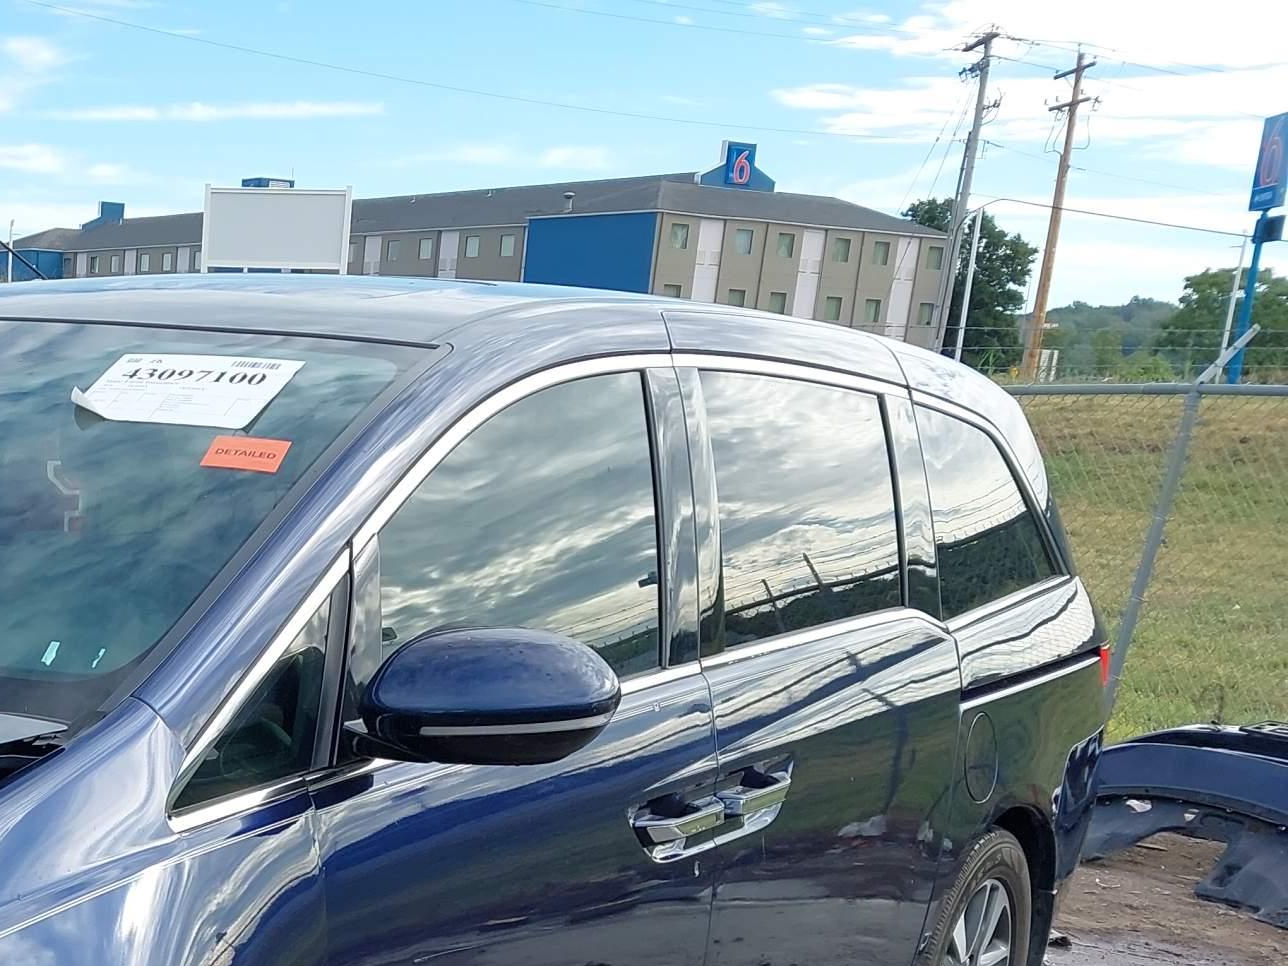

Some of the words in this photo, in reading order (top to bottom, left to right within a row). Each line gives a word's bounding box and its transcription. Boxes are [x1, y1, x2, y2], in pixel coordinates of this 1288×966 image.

[733, 150, 751, 185] 6
[122, 366, 267, 385] 43097100
[214, 447, 278, 460] DETAILED
